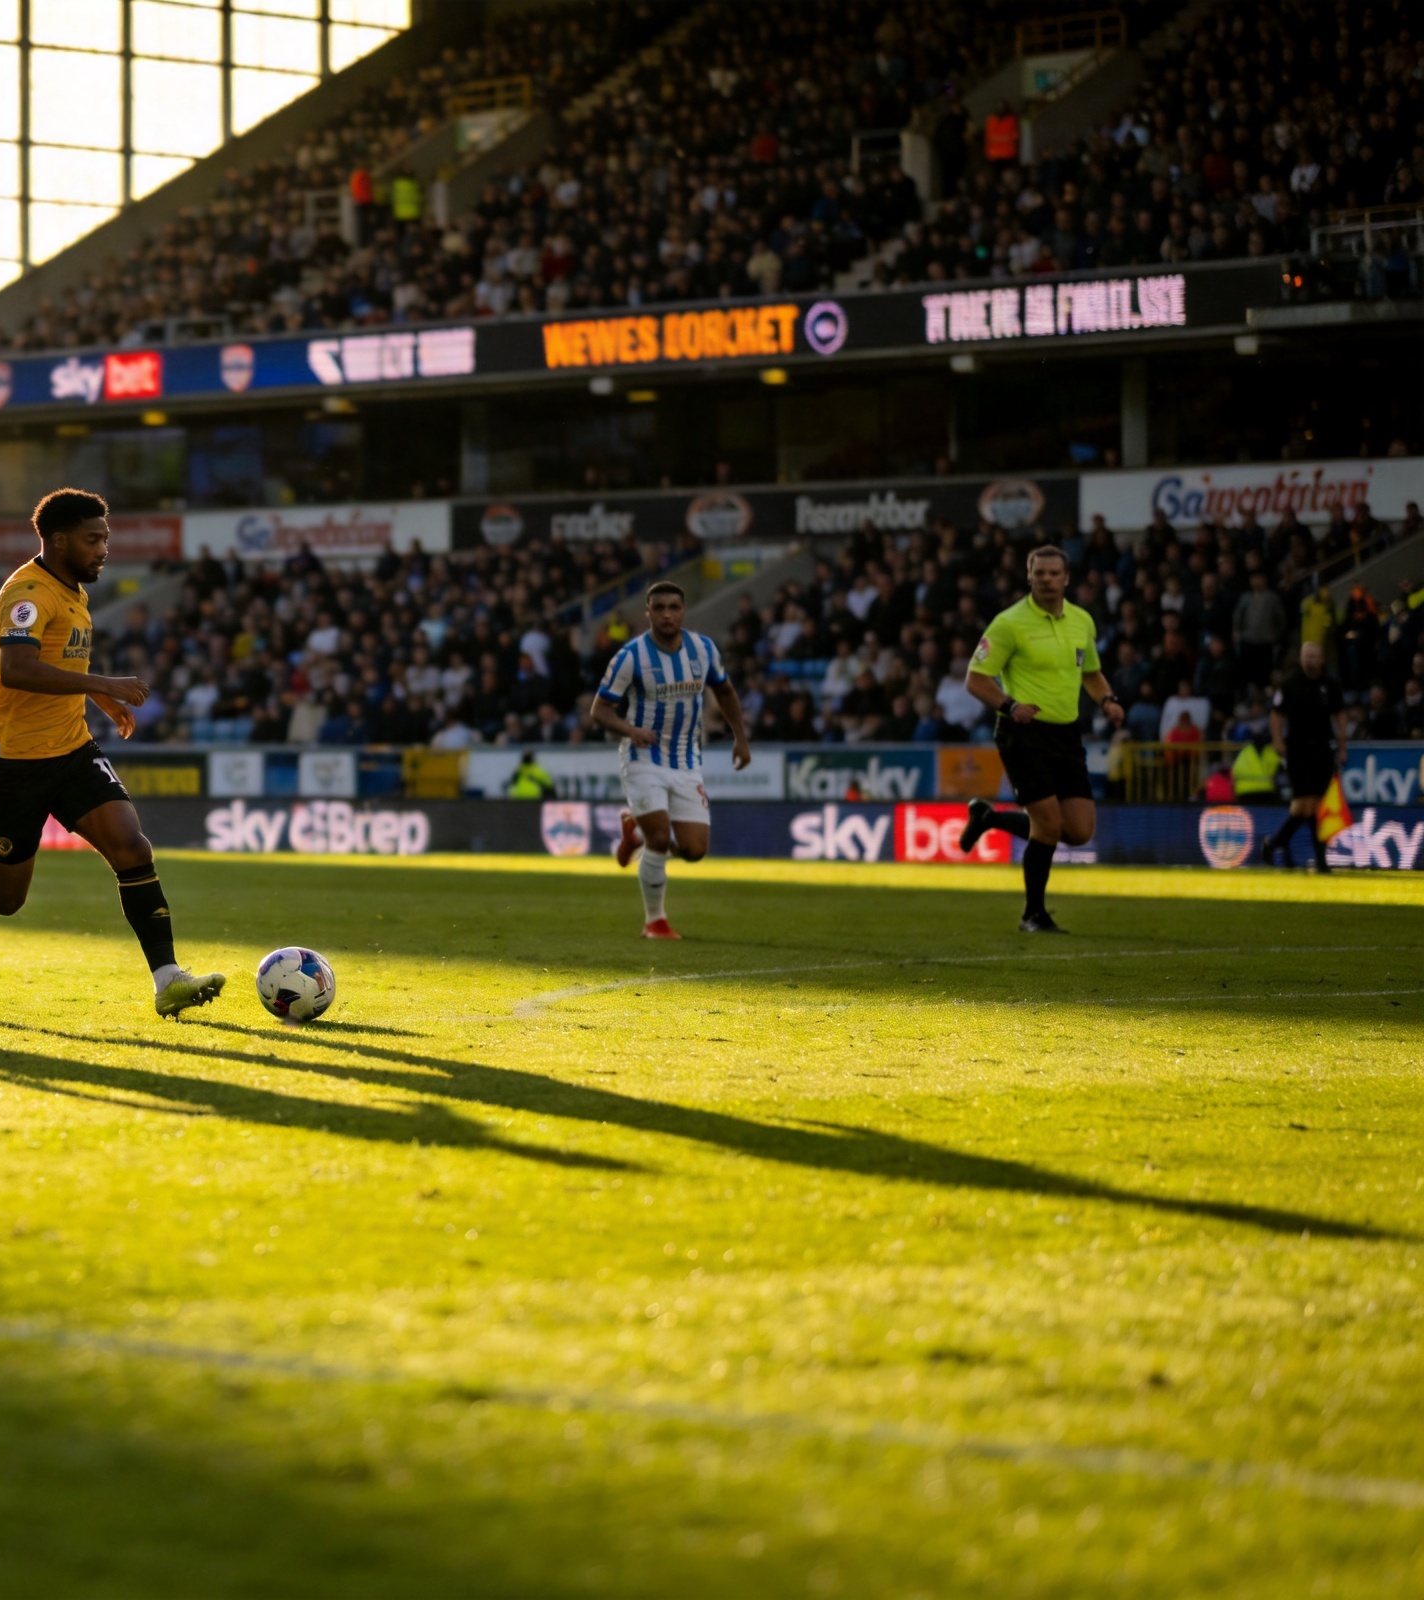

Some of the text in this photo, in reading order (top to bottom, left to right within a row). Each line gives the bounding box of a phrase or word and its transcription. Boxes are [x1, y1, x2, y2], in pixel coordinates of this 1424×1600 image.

[50, 356, 104, 404] sky
[205, 799, 287, 853] sky
[790, 803, 892, 862] sky
